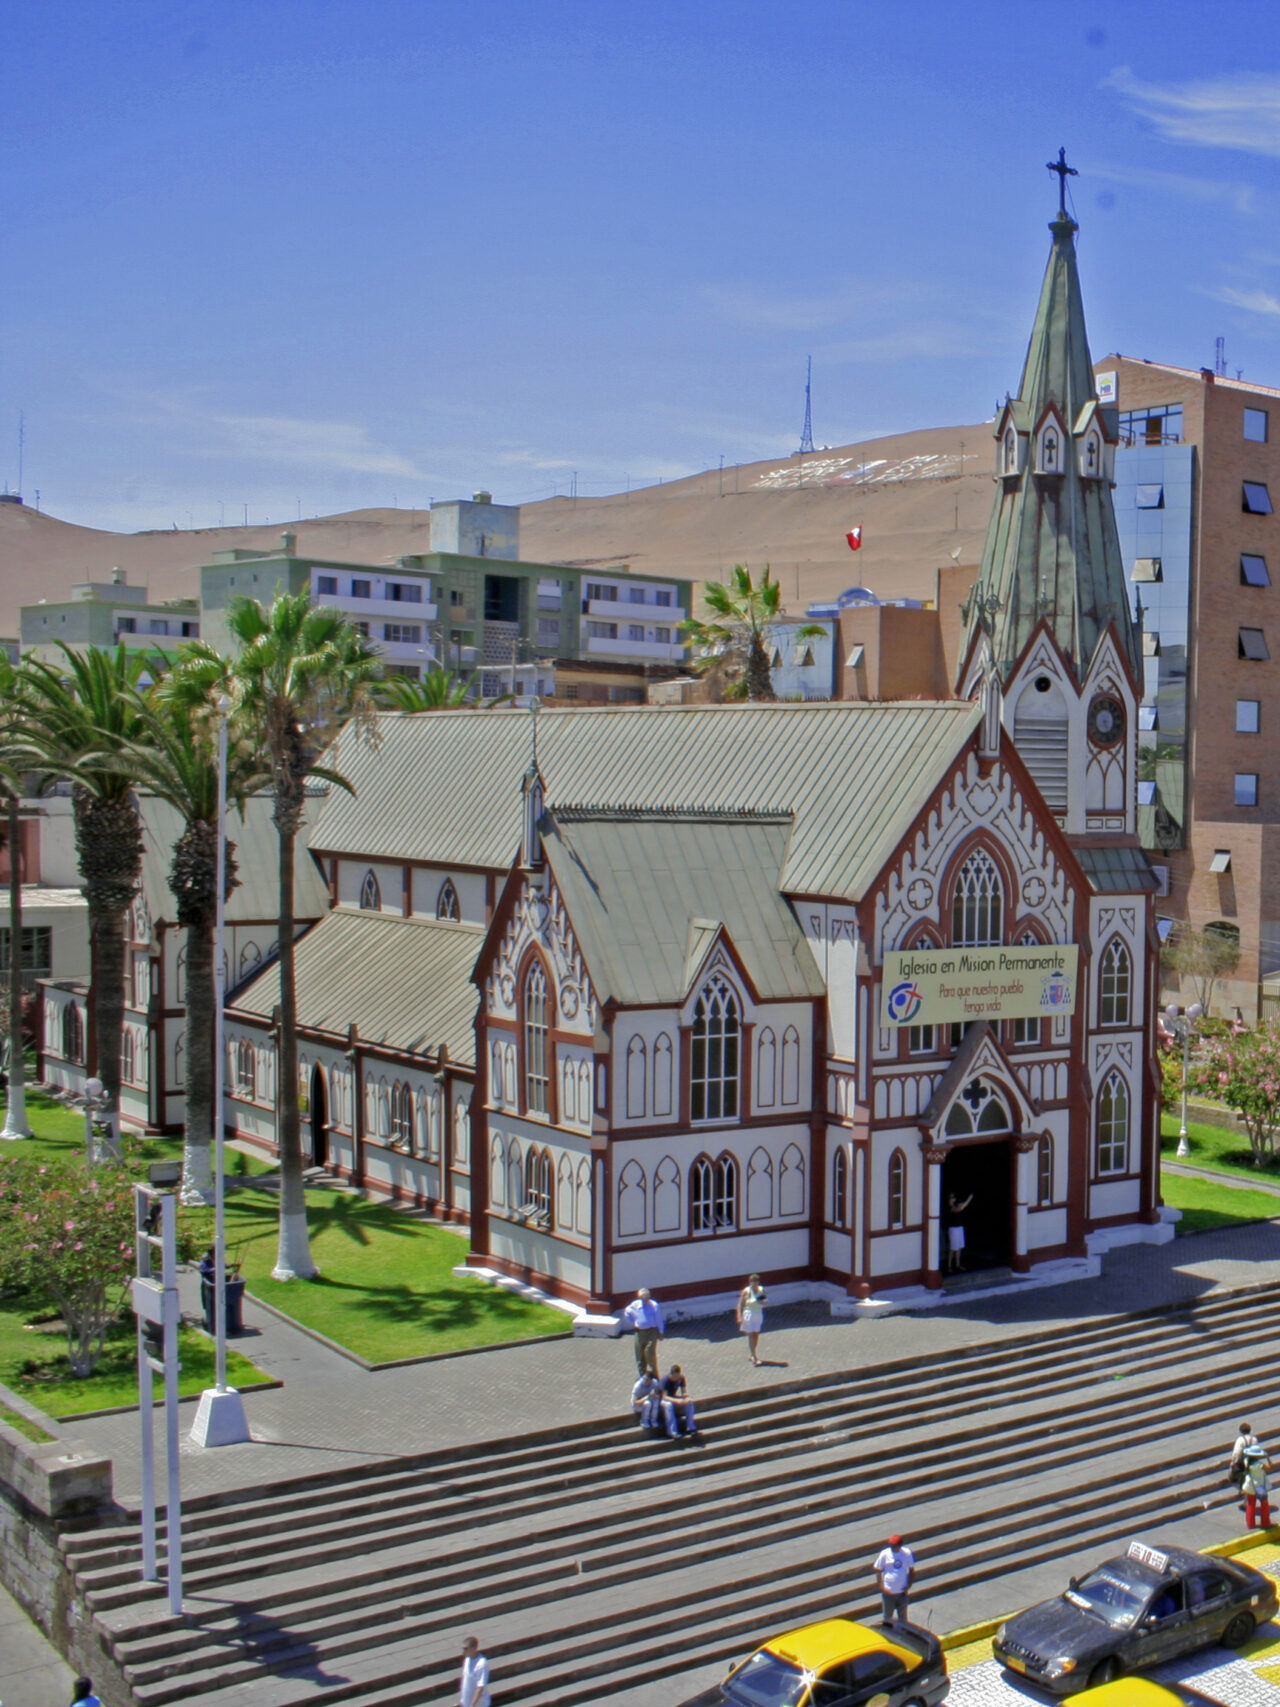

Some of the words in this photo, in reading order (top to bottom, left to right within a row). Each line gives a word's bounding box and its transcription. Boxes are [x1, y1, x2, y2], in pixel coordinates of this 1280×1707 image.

[899, 957, 937, 980] Iglesia
[941, 961, 955, 973] en
[1000, 952, 1065, 971] Permanente
[939, 983, 956, 998] Para
[957, 985, 971, 999] que
[972, 981, 999, 996] nuestro
[1000, 979, 1024, 997] pueblo
[986, 998, 1001, 1012] vida
